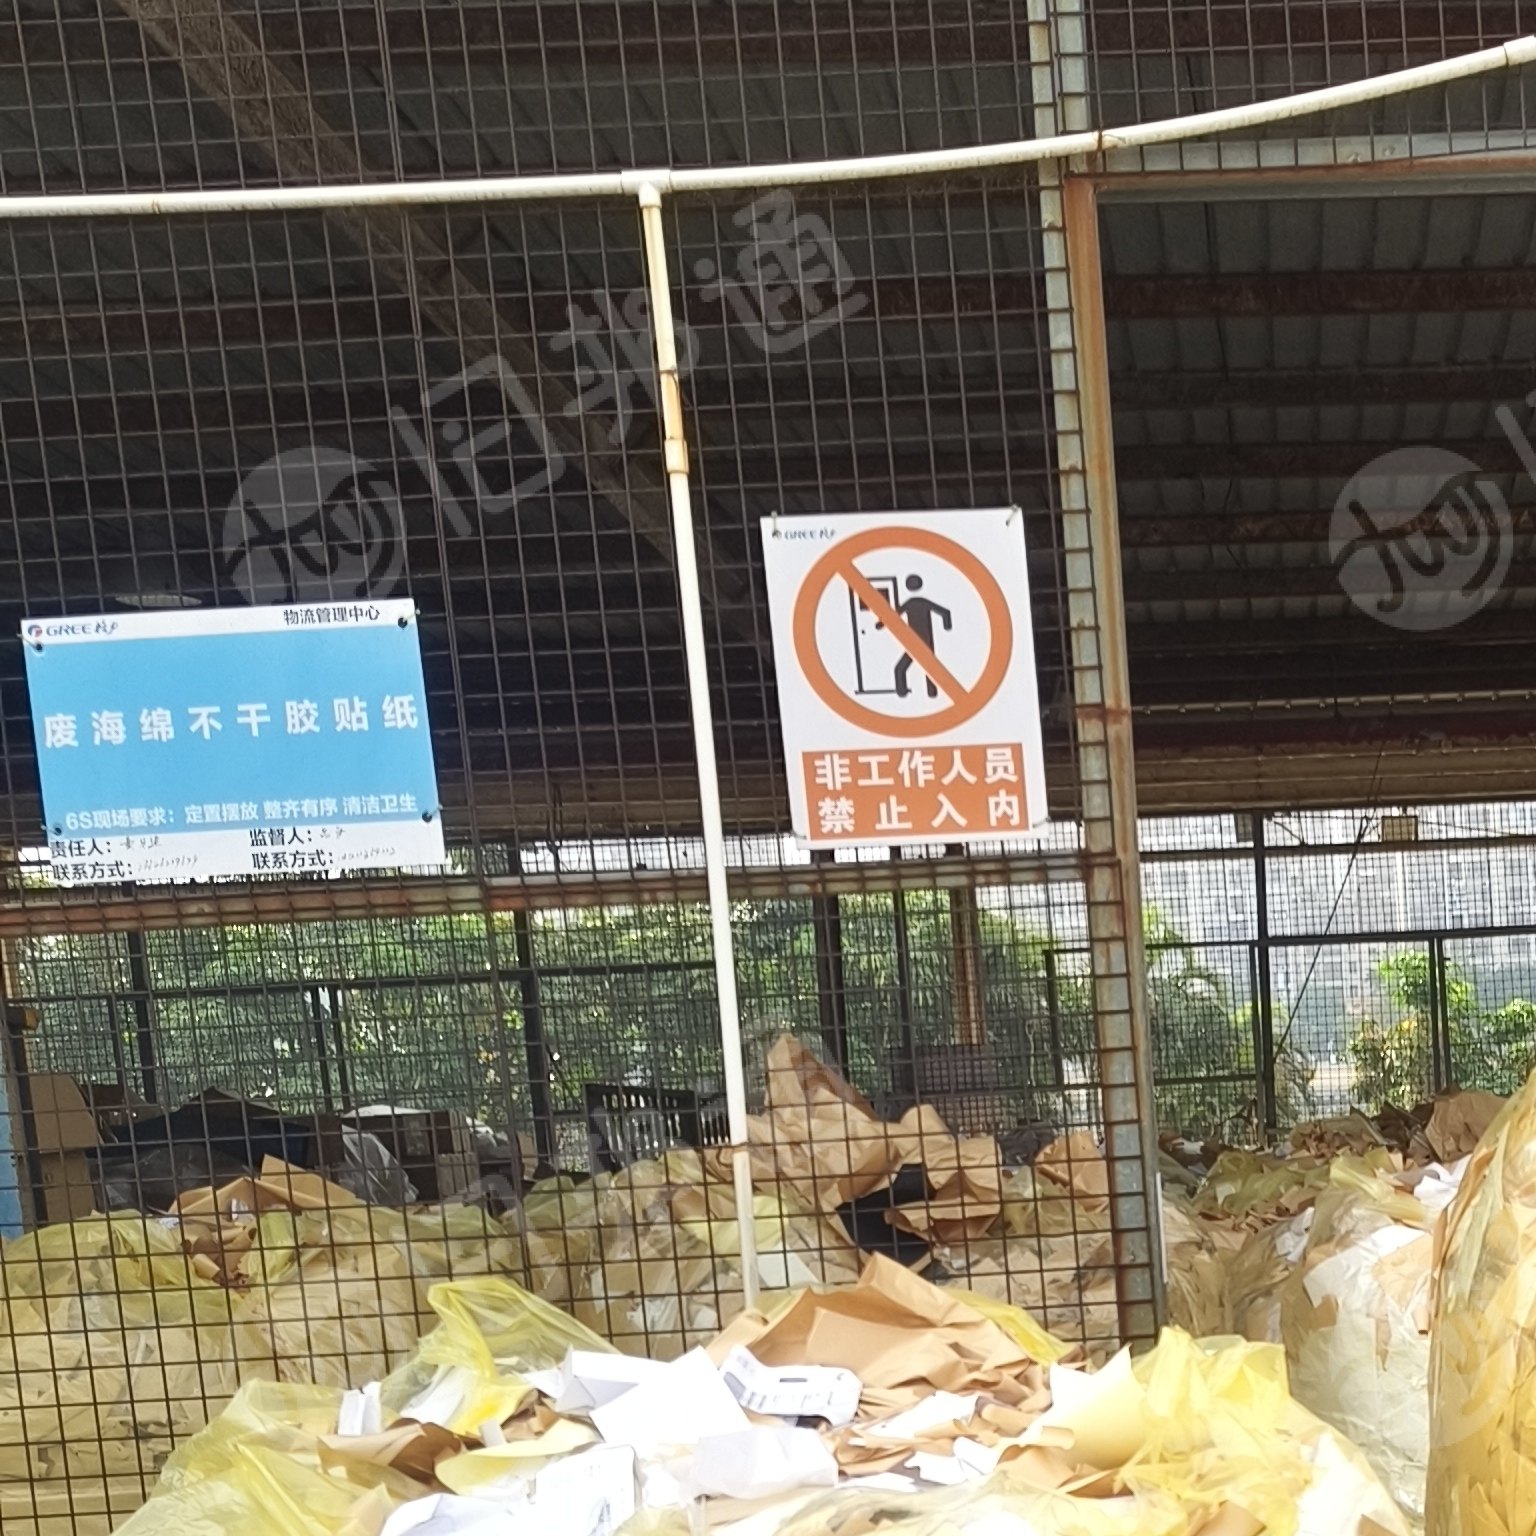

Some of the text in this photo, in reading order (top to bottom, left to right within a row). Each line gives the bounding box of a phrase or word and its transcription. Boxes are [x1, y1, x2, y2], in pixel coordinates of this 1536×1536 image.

[283, 605, 381, 626] 物流管理中心
[46, 624, 92, 637] GREE
[44, 693, 419, 749] 废海绵不干胶贴纸
[814, 747, 1019, 791] 非工作人员
[264, 798, 339, 820] 整齐有序
[343, 794, 419, 816] 清洁卫生
[818, 789, 1021, 834] 禁止入内
[50, 838, 112, 859] 责任人：
[249, 827, 312, 848] 监督人：
[53, 860, 134, 882] 联系方式：
[252, 849, 334, 871] 联系方式：
